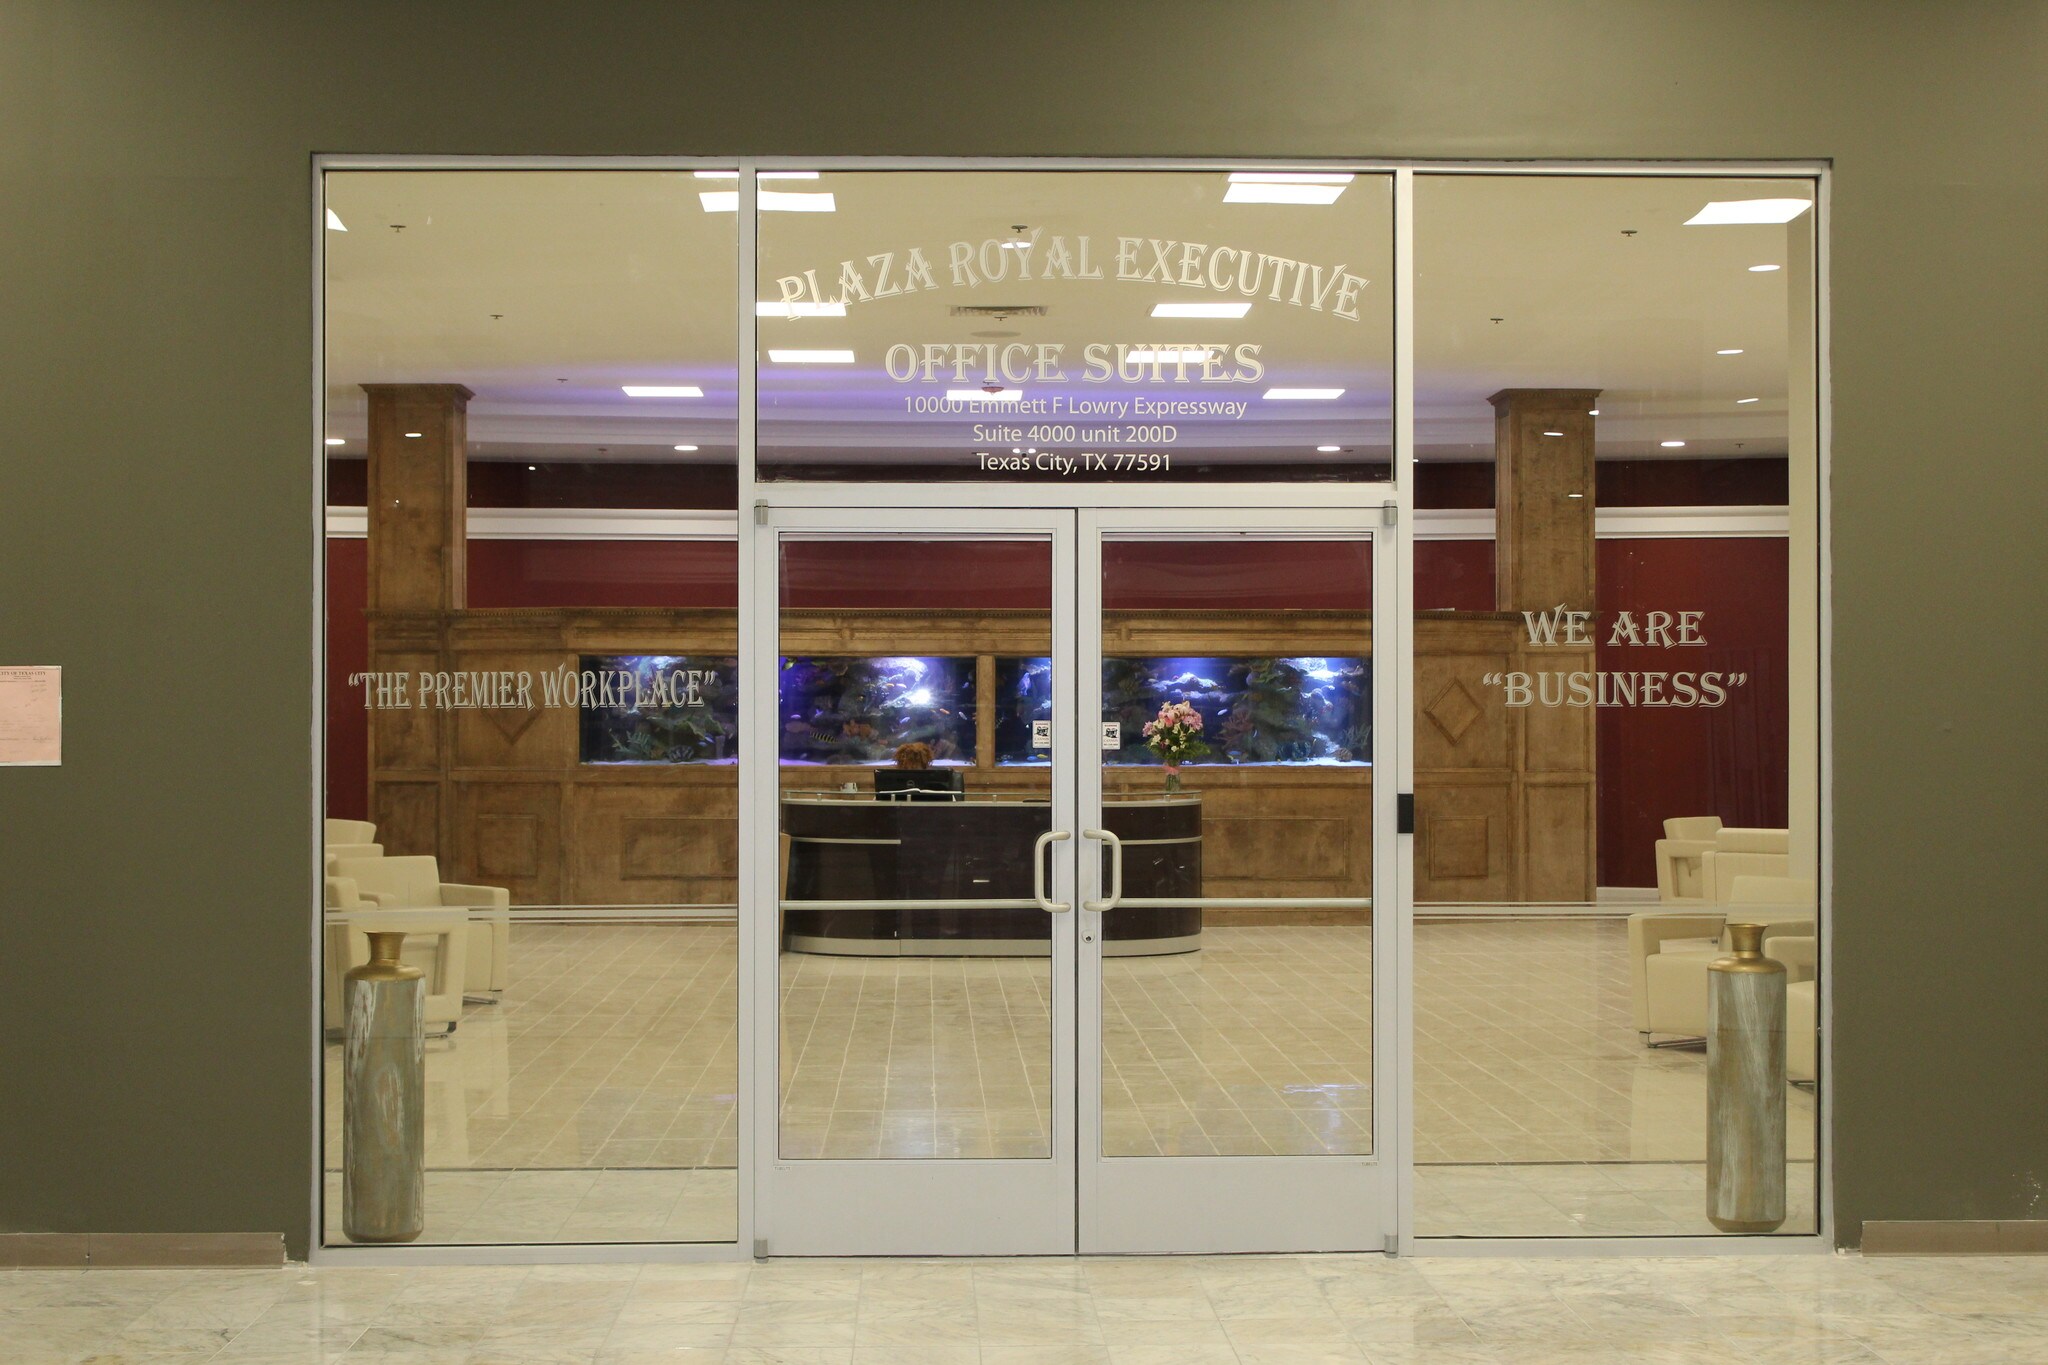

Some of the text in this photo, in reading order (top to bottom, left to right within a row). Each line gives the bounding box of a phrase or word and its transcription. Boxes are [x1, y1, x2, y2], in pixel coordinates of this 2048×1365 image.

[776, 227, 1370, 321] PLAZA ROYAL EXECUTIVE
[885, 343, 1265, 383] OFFICE SUITES
[904, 396, 1247, 419] 10000 Emmett F Lowry Expressway
[973, 424, 1177, 443] Suite 4000 unit 200D
[977, 453, 1171, 474] Texas City, TX 77591
[1521, 603, 1708, 649] WE ARE
[418, 670, 535, 712] PREMIER
